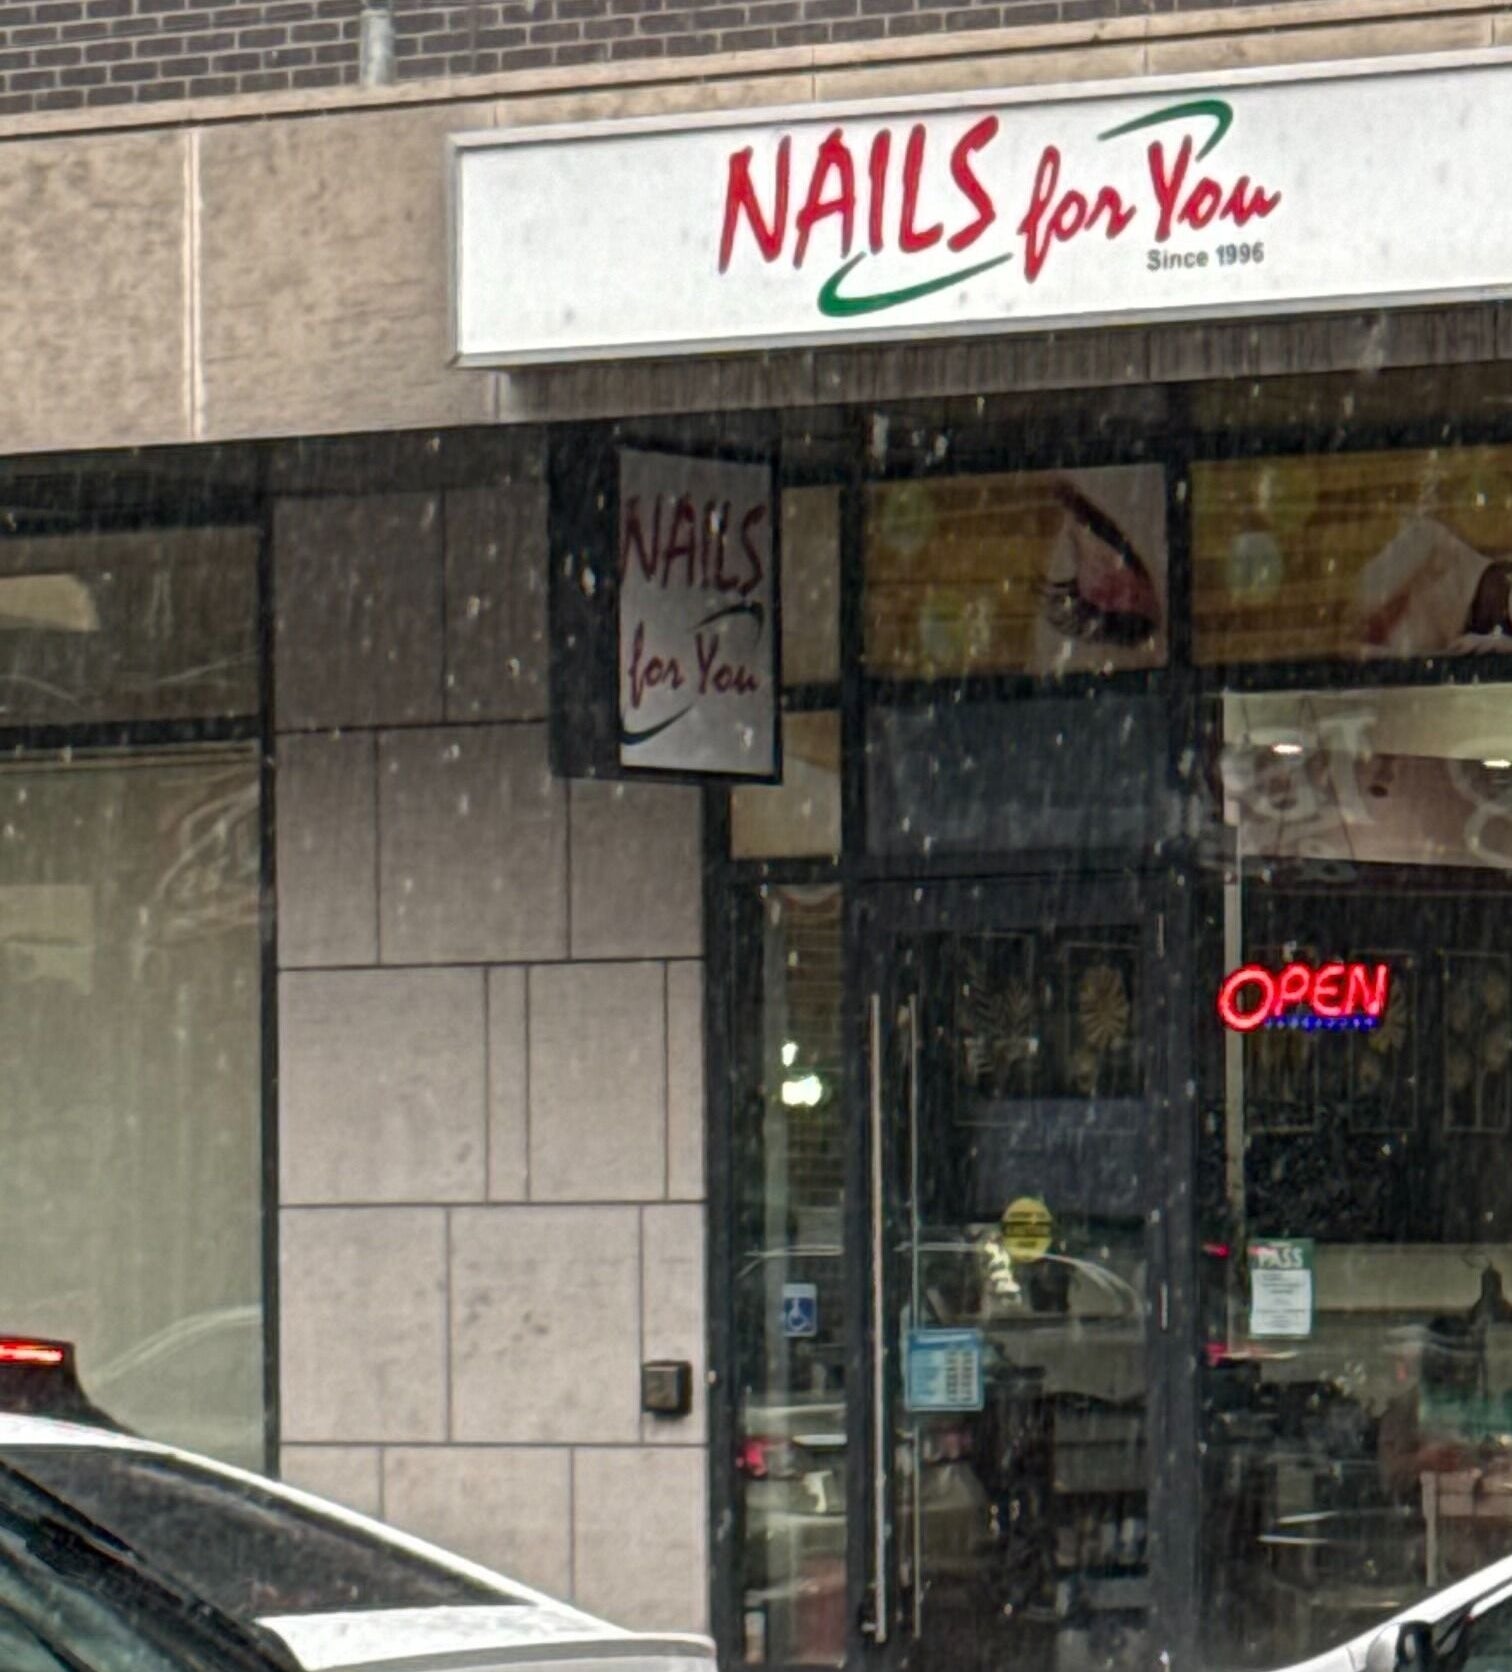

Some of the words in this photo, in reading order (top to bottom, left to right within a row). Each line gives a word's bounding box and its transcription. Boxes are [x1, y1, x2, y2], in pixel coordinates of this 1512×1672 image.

[718, 115, 999, 275] NAILS
[1016, 145, 1136, 283] for
[1147, 134, 1282, 242] You
[1146, 248, 1209, 271] Since
[1215, 241, 1265, 266] 1996
[619, 492, 766, 597] NAILS
[629, 620, 684, 710] for
[694, 632, 760, 696] You
[1217, 962, 1389, 1033] OPEN
[1258, 1246, 1304, 1270] PASS
